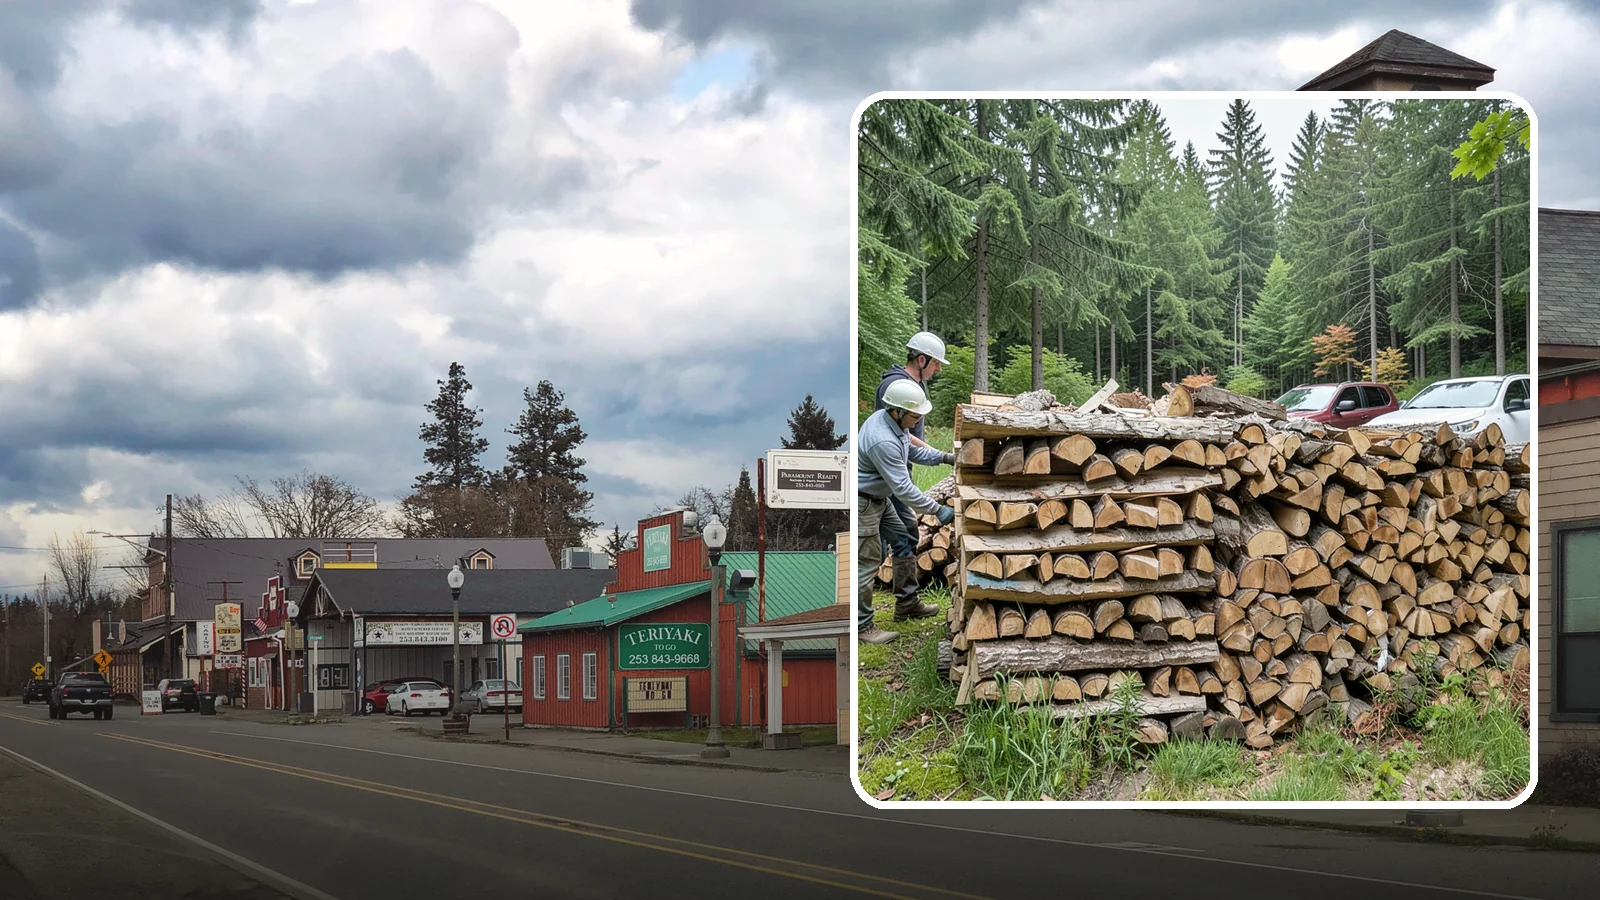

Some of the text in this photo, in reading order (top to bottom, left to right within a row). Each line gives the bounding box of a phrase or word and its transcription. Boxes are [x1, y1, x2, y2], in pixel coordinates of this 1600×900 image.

[781, 471, 839, 480] PARAMOUNT REALTY
[624, 627, 703, 646] TERIYAKI
[653, 643, 677, 651] TO GO
[628, 653, 700, 665] 253 843-9668
[639, 681, 672, 690] TERIYAKI
